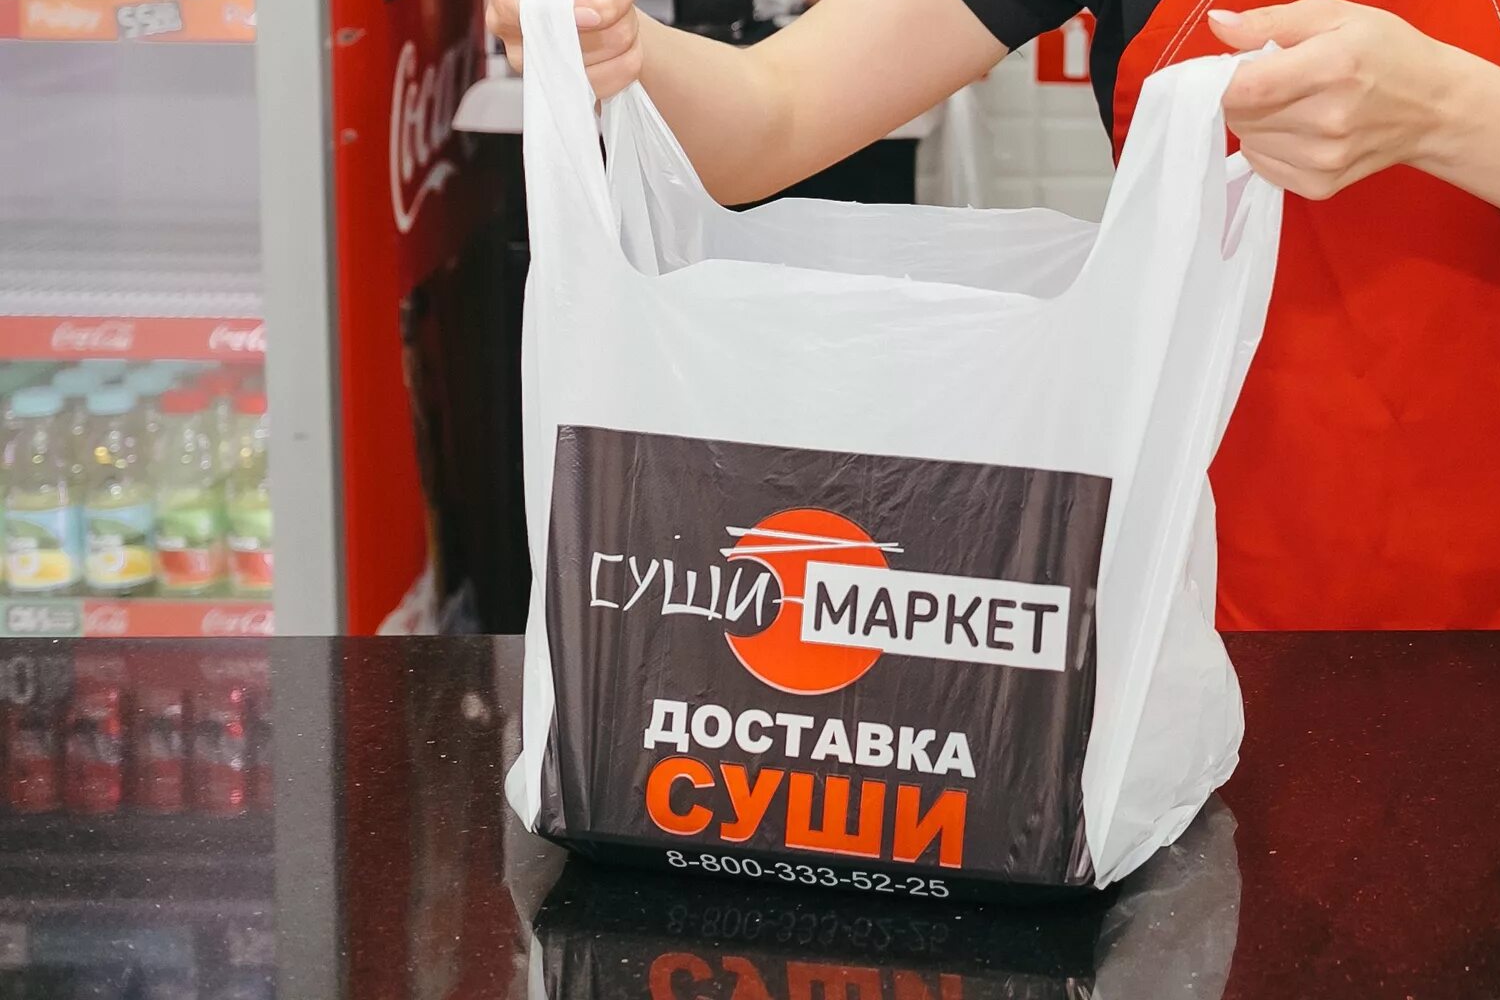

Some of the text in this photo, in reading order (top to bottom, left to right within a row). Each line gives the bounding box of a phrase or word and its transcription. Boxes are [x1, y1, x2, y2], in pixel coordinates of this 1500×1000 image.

[590, 551, 1059, 655] СУШИ МАРКЕТ
[642, 698, 976, 779] ДОСТАВКА
[644, 757, 968, 869] СУШИ
[666, 850, 950, 899] 8-800-333-52-25
